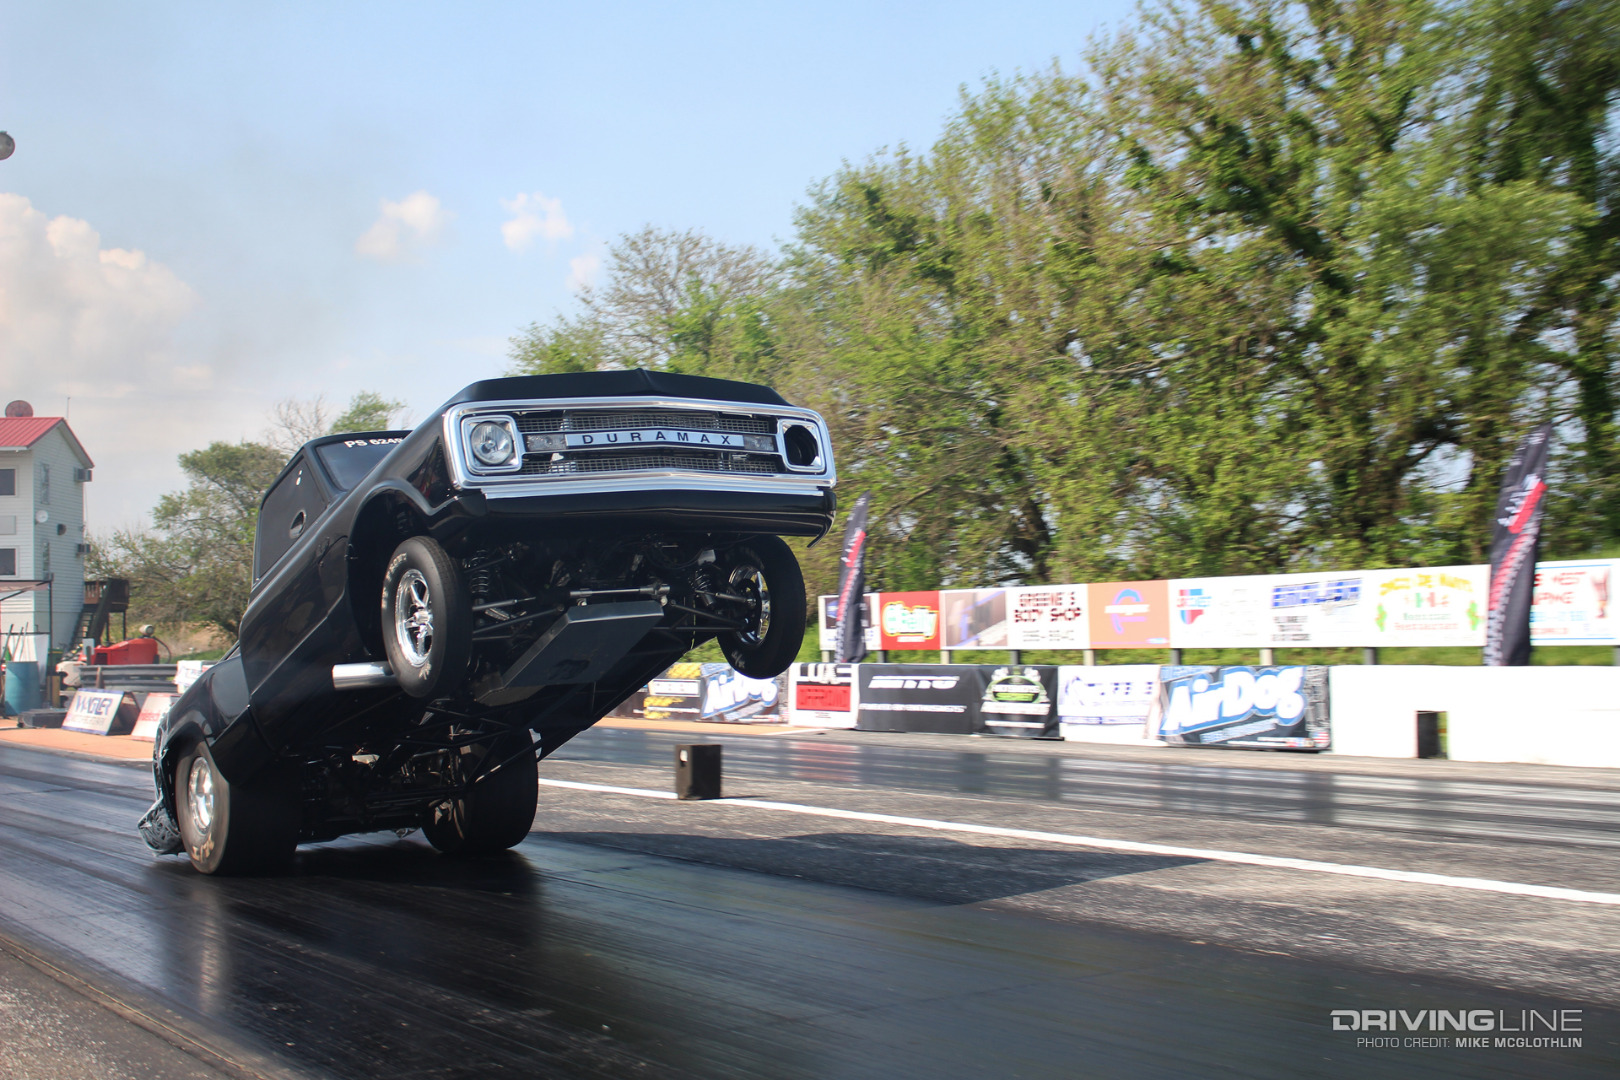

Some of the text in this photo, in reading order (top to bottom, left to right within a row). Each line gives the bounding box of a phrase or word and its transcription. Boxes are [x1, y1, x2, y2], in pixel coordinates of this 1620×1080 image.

[344, 439, 368, 448] PS
[582, 430, 731, 445] DURAMAX
[1160, 666, 1304, 732] AirDog
